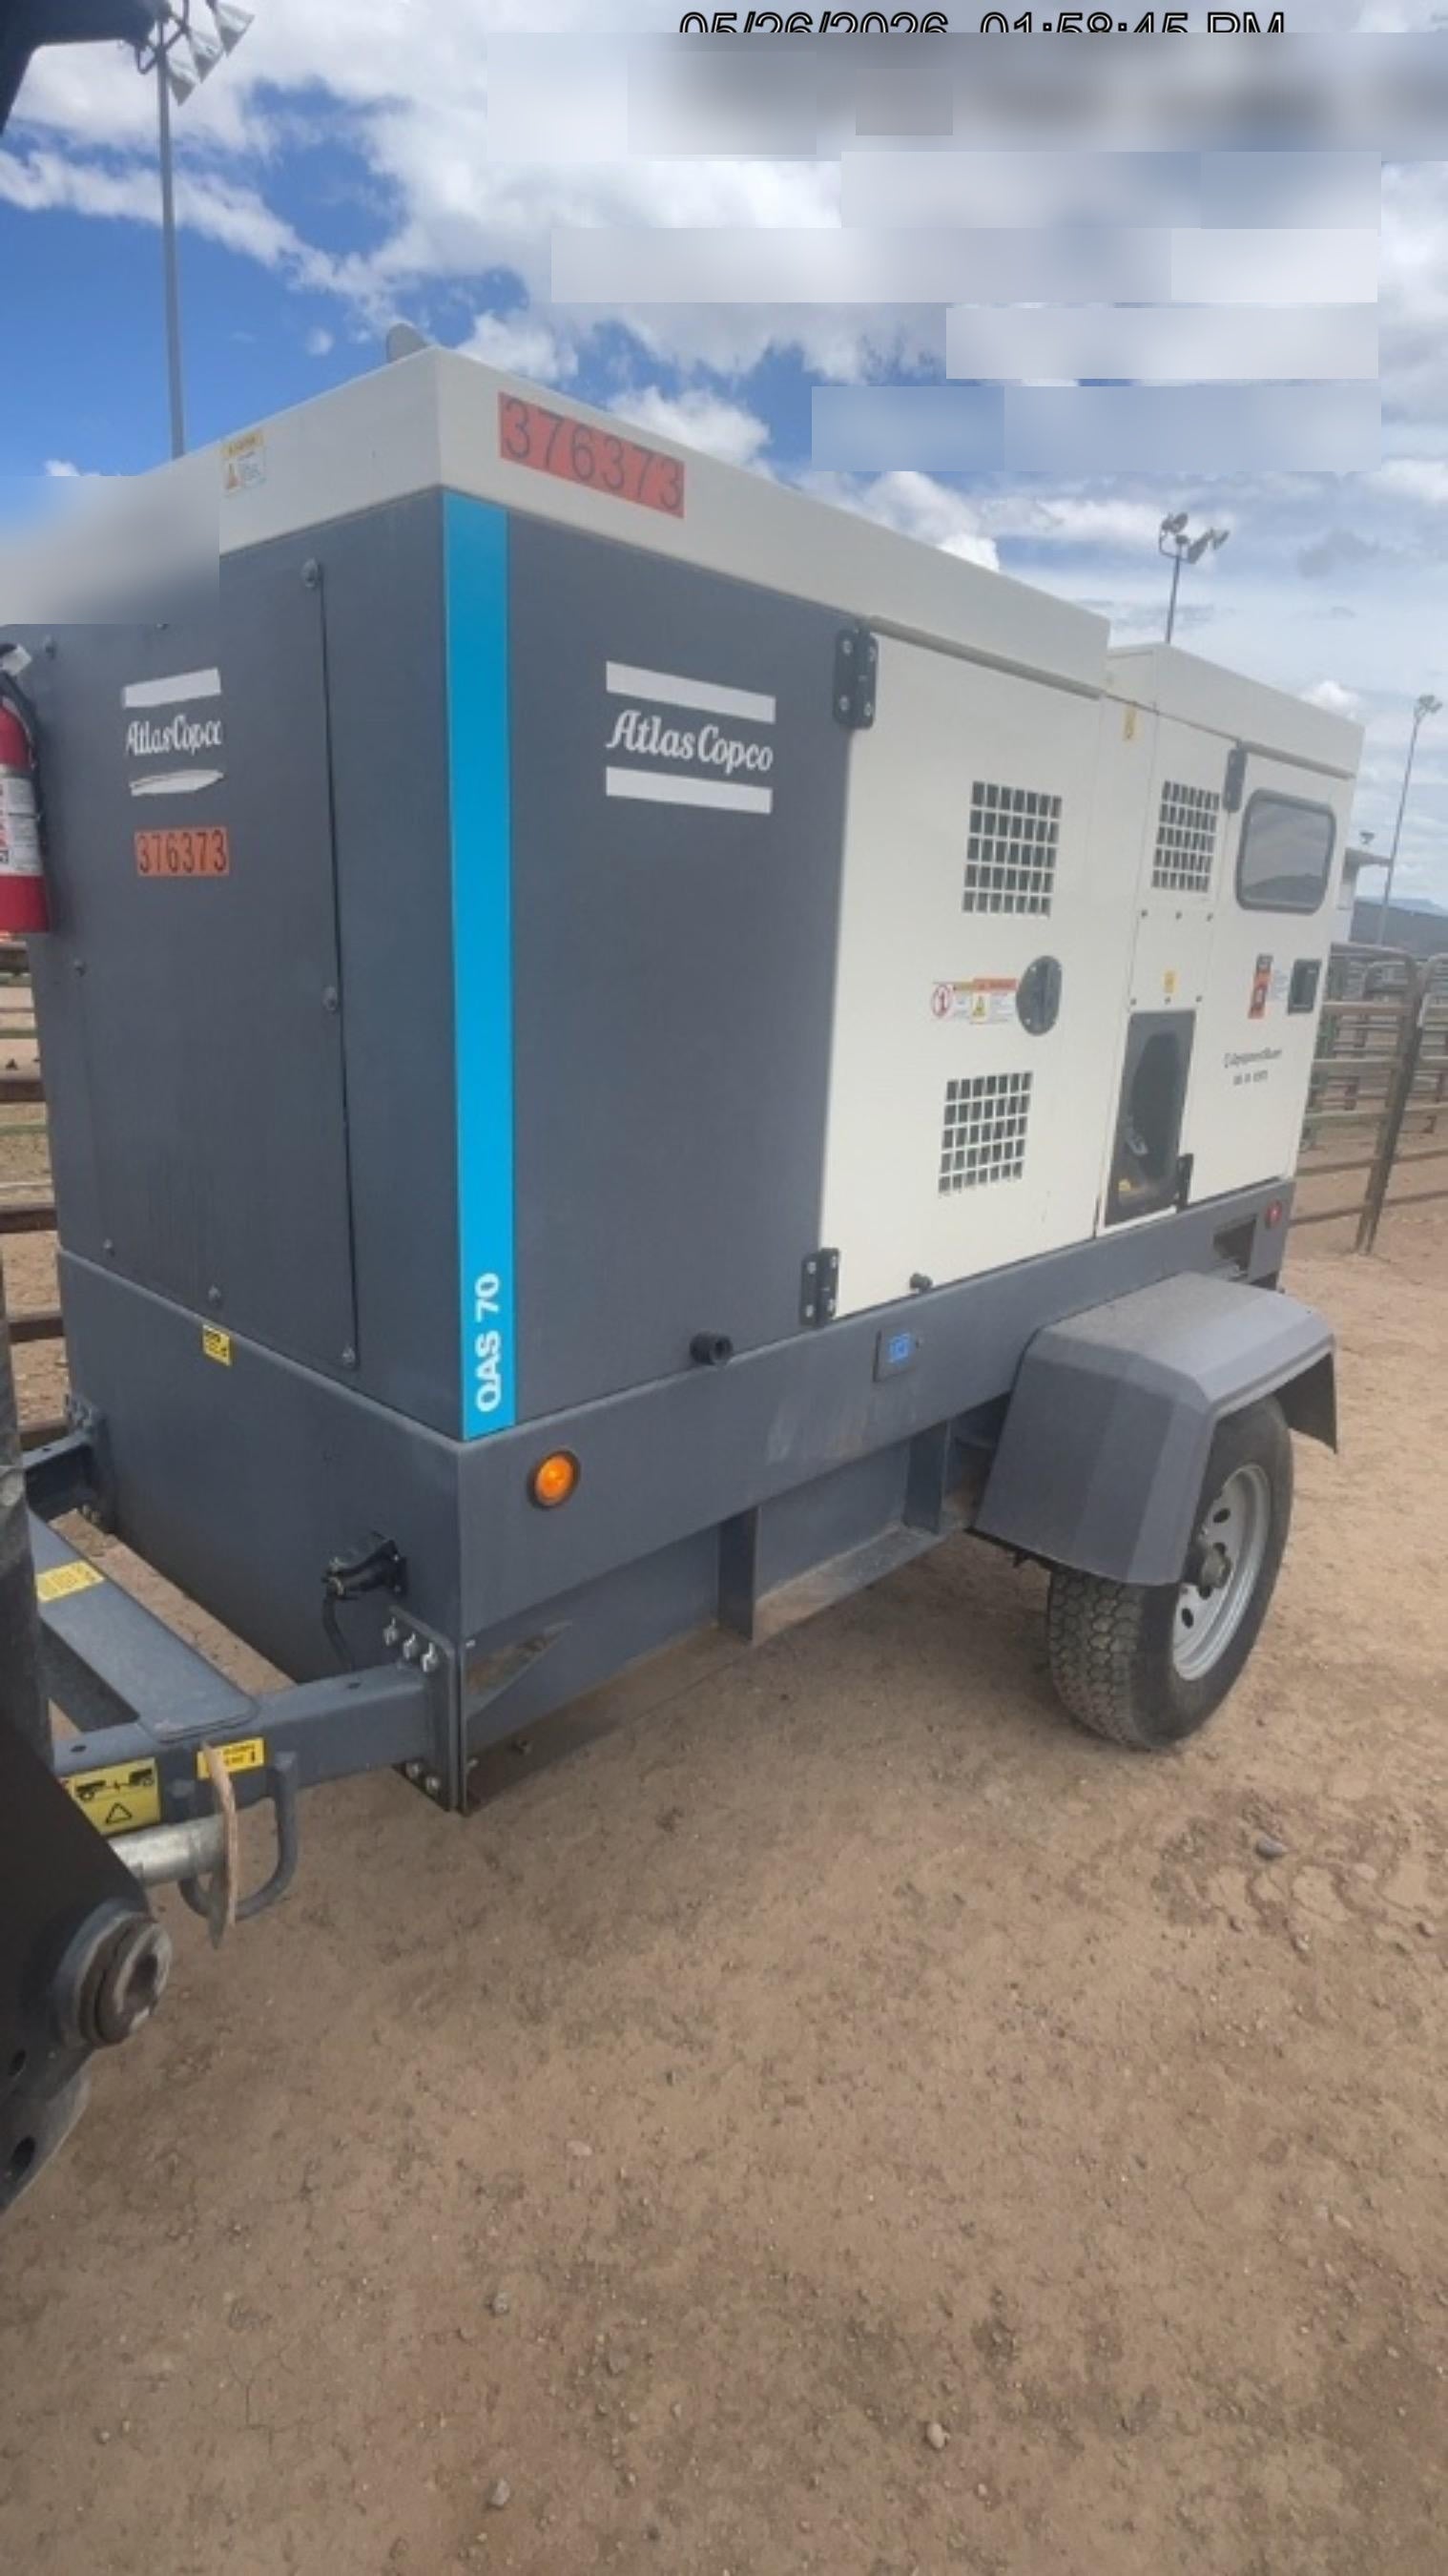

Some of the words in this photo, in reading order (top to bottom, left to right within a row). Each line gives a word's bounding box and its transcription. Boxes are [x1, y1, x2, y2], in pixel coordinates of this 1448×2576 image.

[504, 397, 683, 510] 376373
[605, 709, 696, 760] Atlas
[697, 723, 774, 776] Copco
[139, 830, 227, 873] 376373
[475, 1273, 500, 1323] 70
[475, 1330, 502, 1412] QAS
